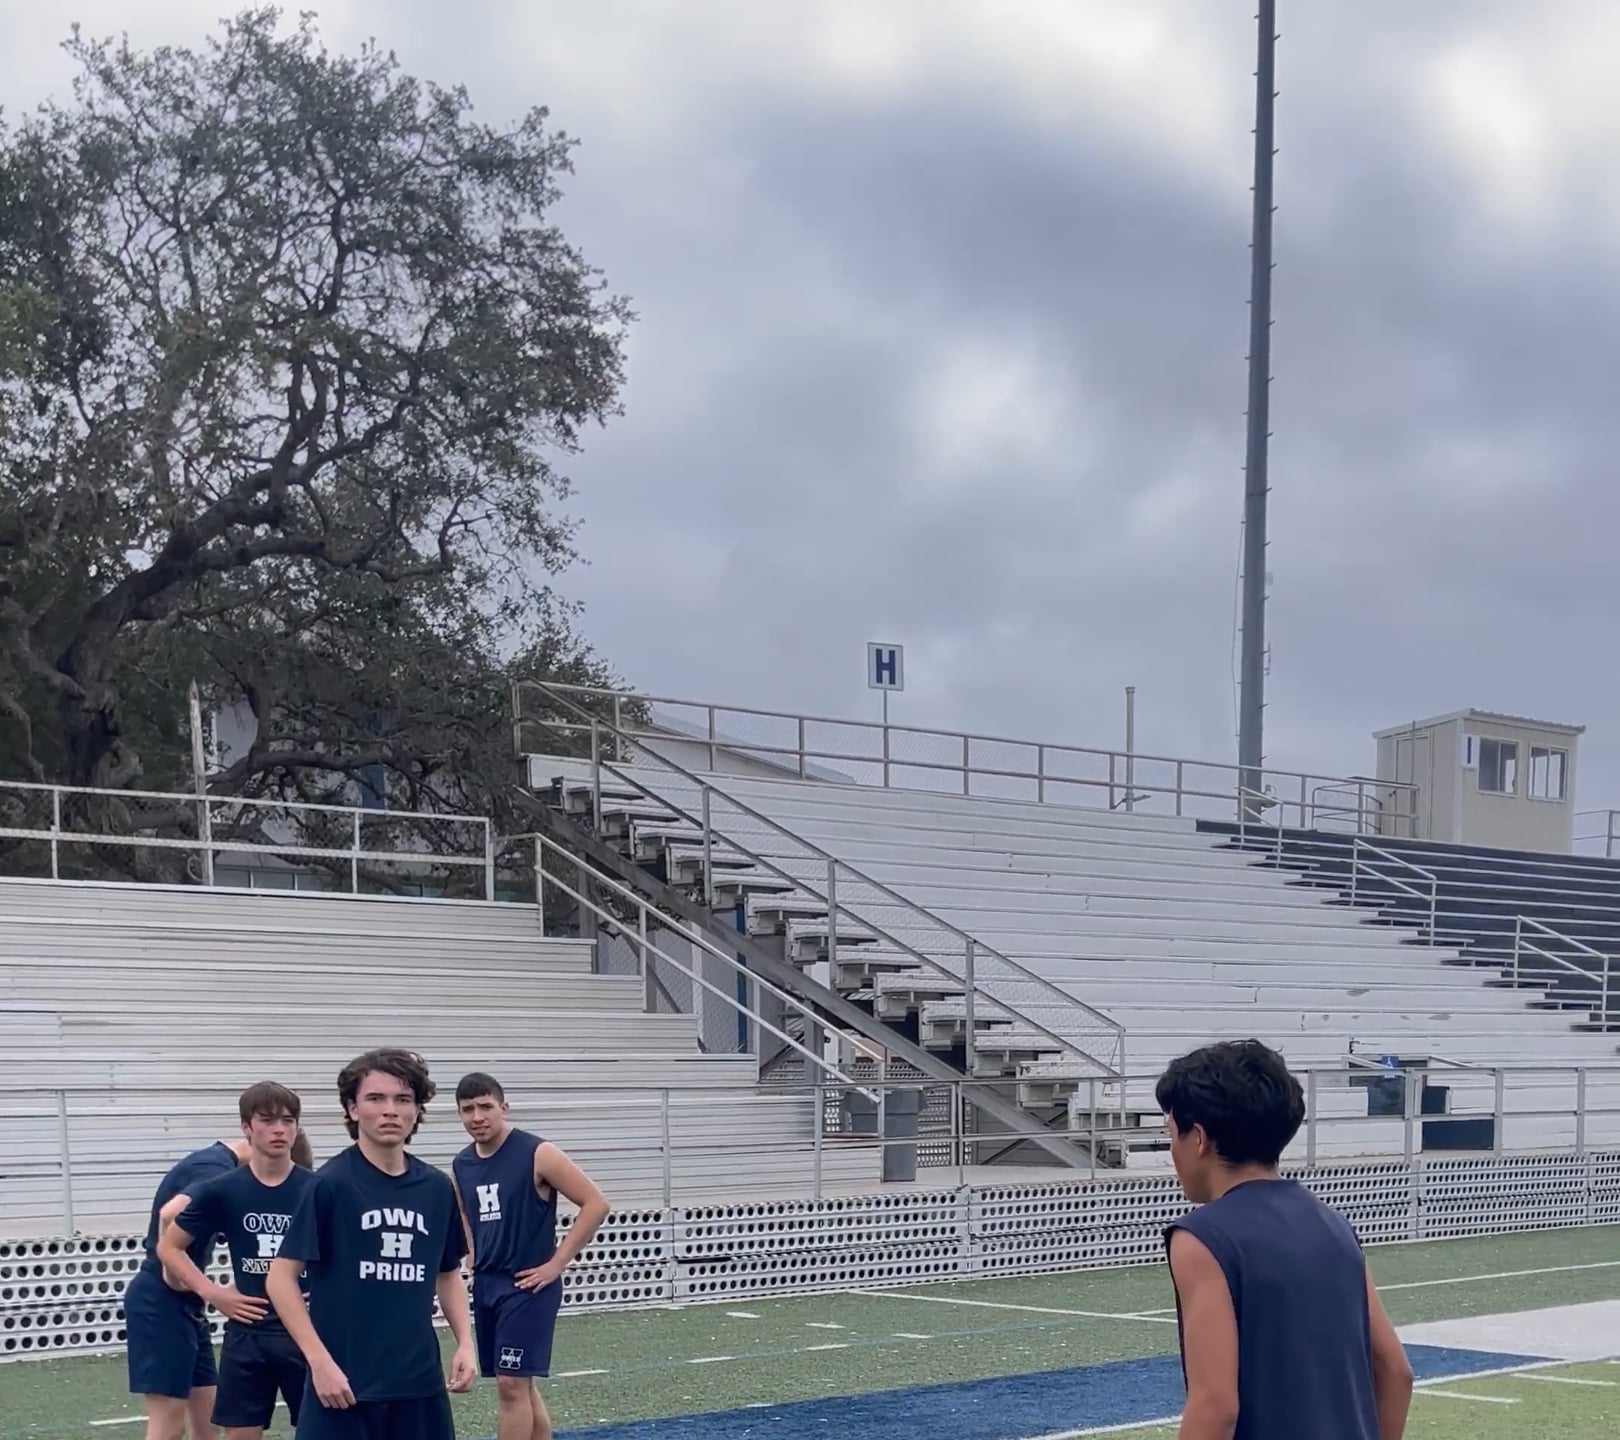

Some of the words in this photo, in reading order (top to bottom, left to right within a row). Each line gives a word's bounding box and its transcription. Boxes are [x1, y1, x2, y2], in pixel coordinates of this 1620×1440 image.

[876, 648, 896, 685] H
[476, 1183, 500, 1213] H
[361, 1208, 429, 1235] OWL
[380, 1232, 414, 1258] H
[359, 1260, 426, 1282] PRIDE
